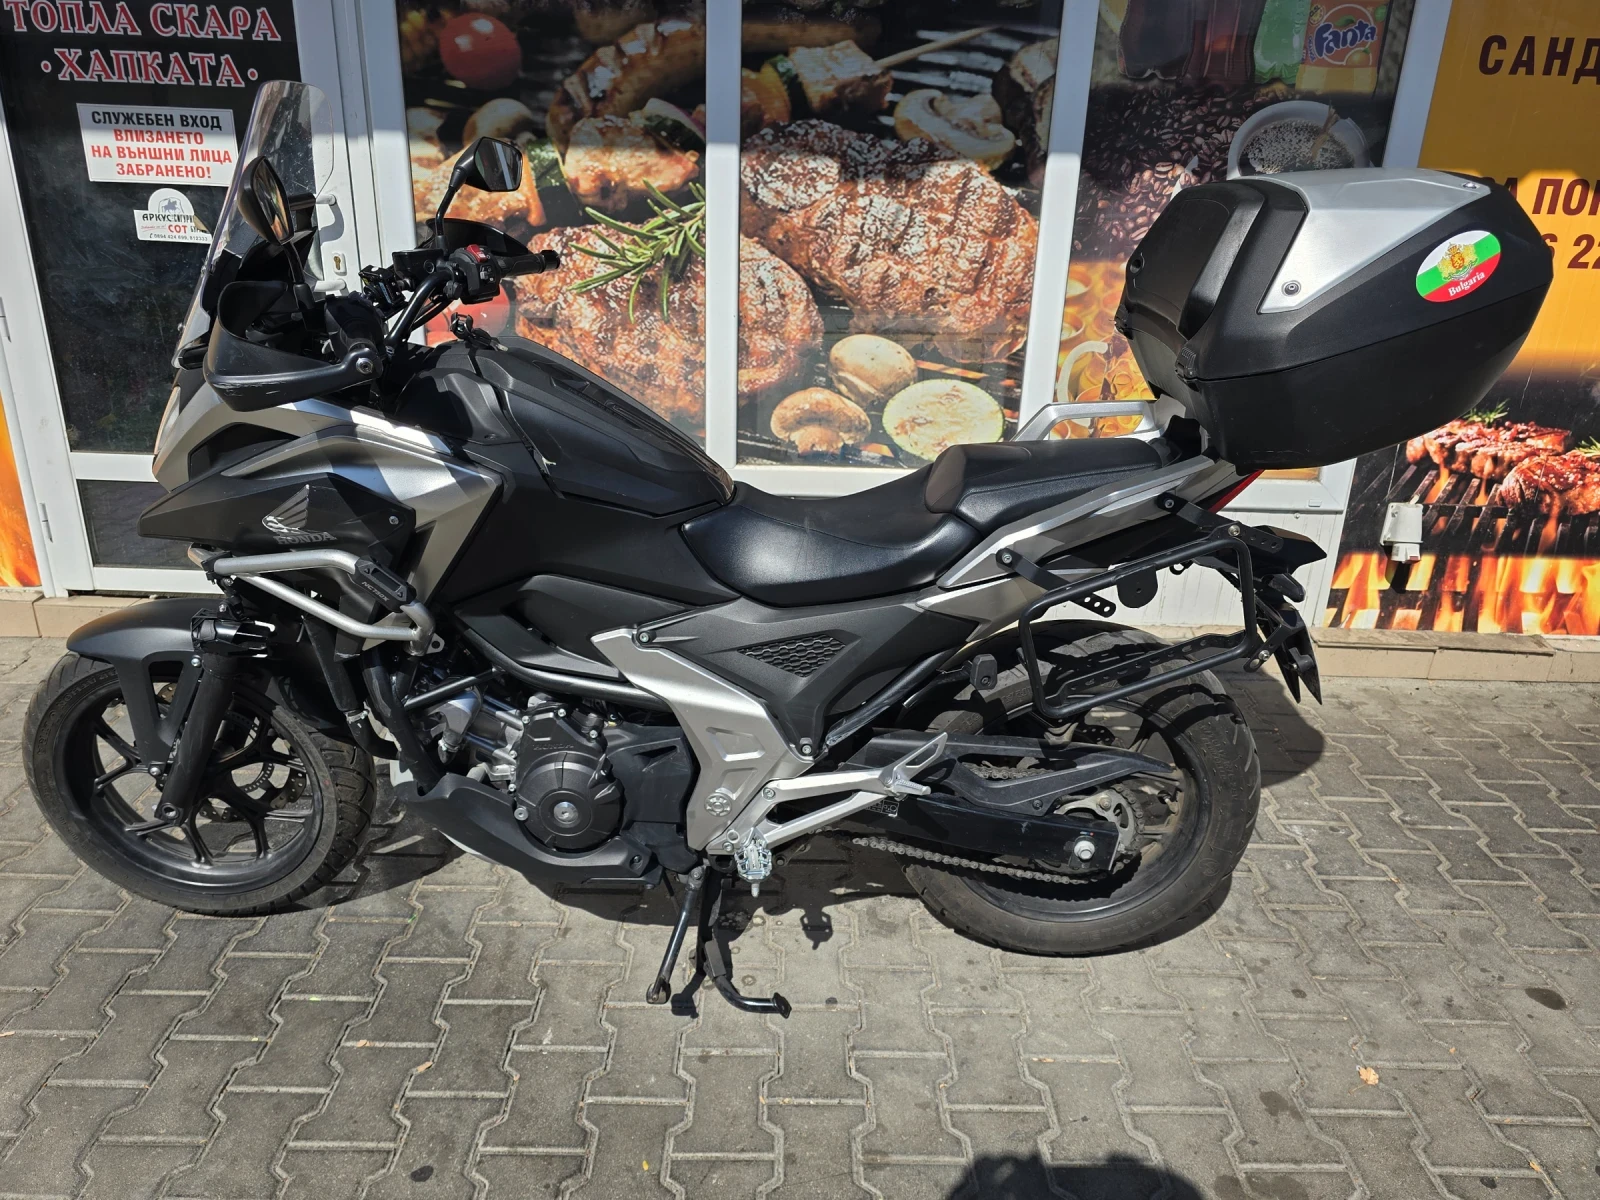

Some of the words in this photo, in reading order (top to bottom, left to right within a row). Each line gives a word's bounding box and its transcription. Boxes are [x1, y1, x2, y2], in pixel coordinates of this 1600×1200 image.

[4, 0, 142, 36] ТОПЛА
[150, 3, 281, 42] СКАРА
[1314, 19, 1377, 58] Fanta
[91, 110, 175, 127] СЛУЖЕБЕН
[179, 114, 222, 131] ВХОД
[113, 128, 204, 145] ВЛИЗАНЕТО
[91, 145, 113, 159] НА
[116, 146, 185, 161] ВЪНШНИ
[189, 149, 232, 165] ЛИЦА
[115, 163, 212, 179] ЗАБРАНЕНО!
[168, 224, 188, 234] СОТ
[1448, 272, 1485, 297] Bulgaria
[273, 531, 337, 545] HONDA
